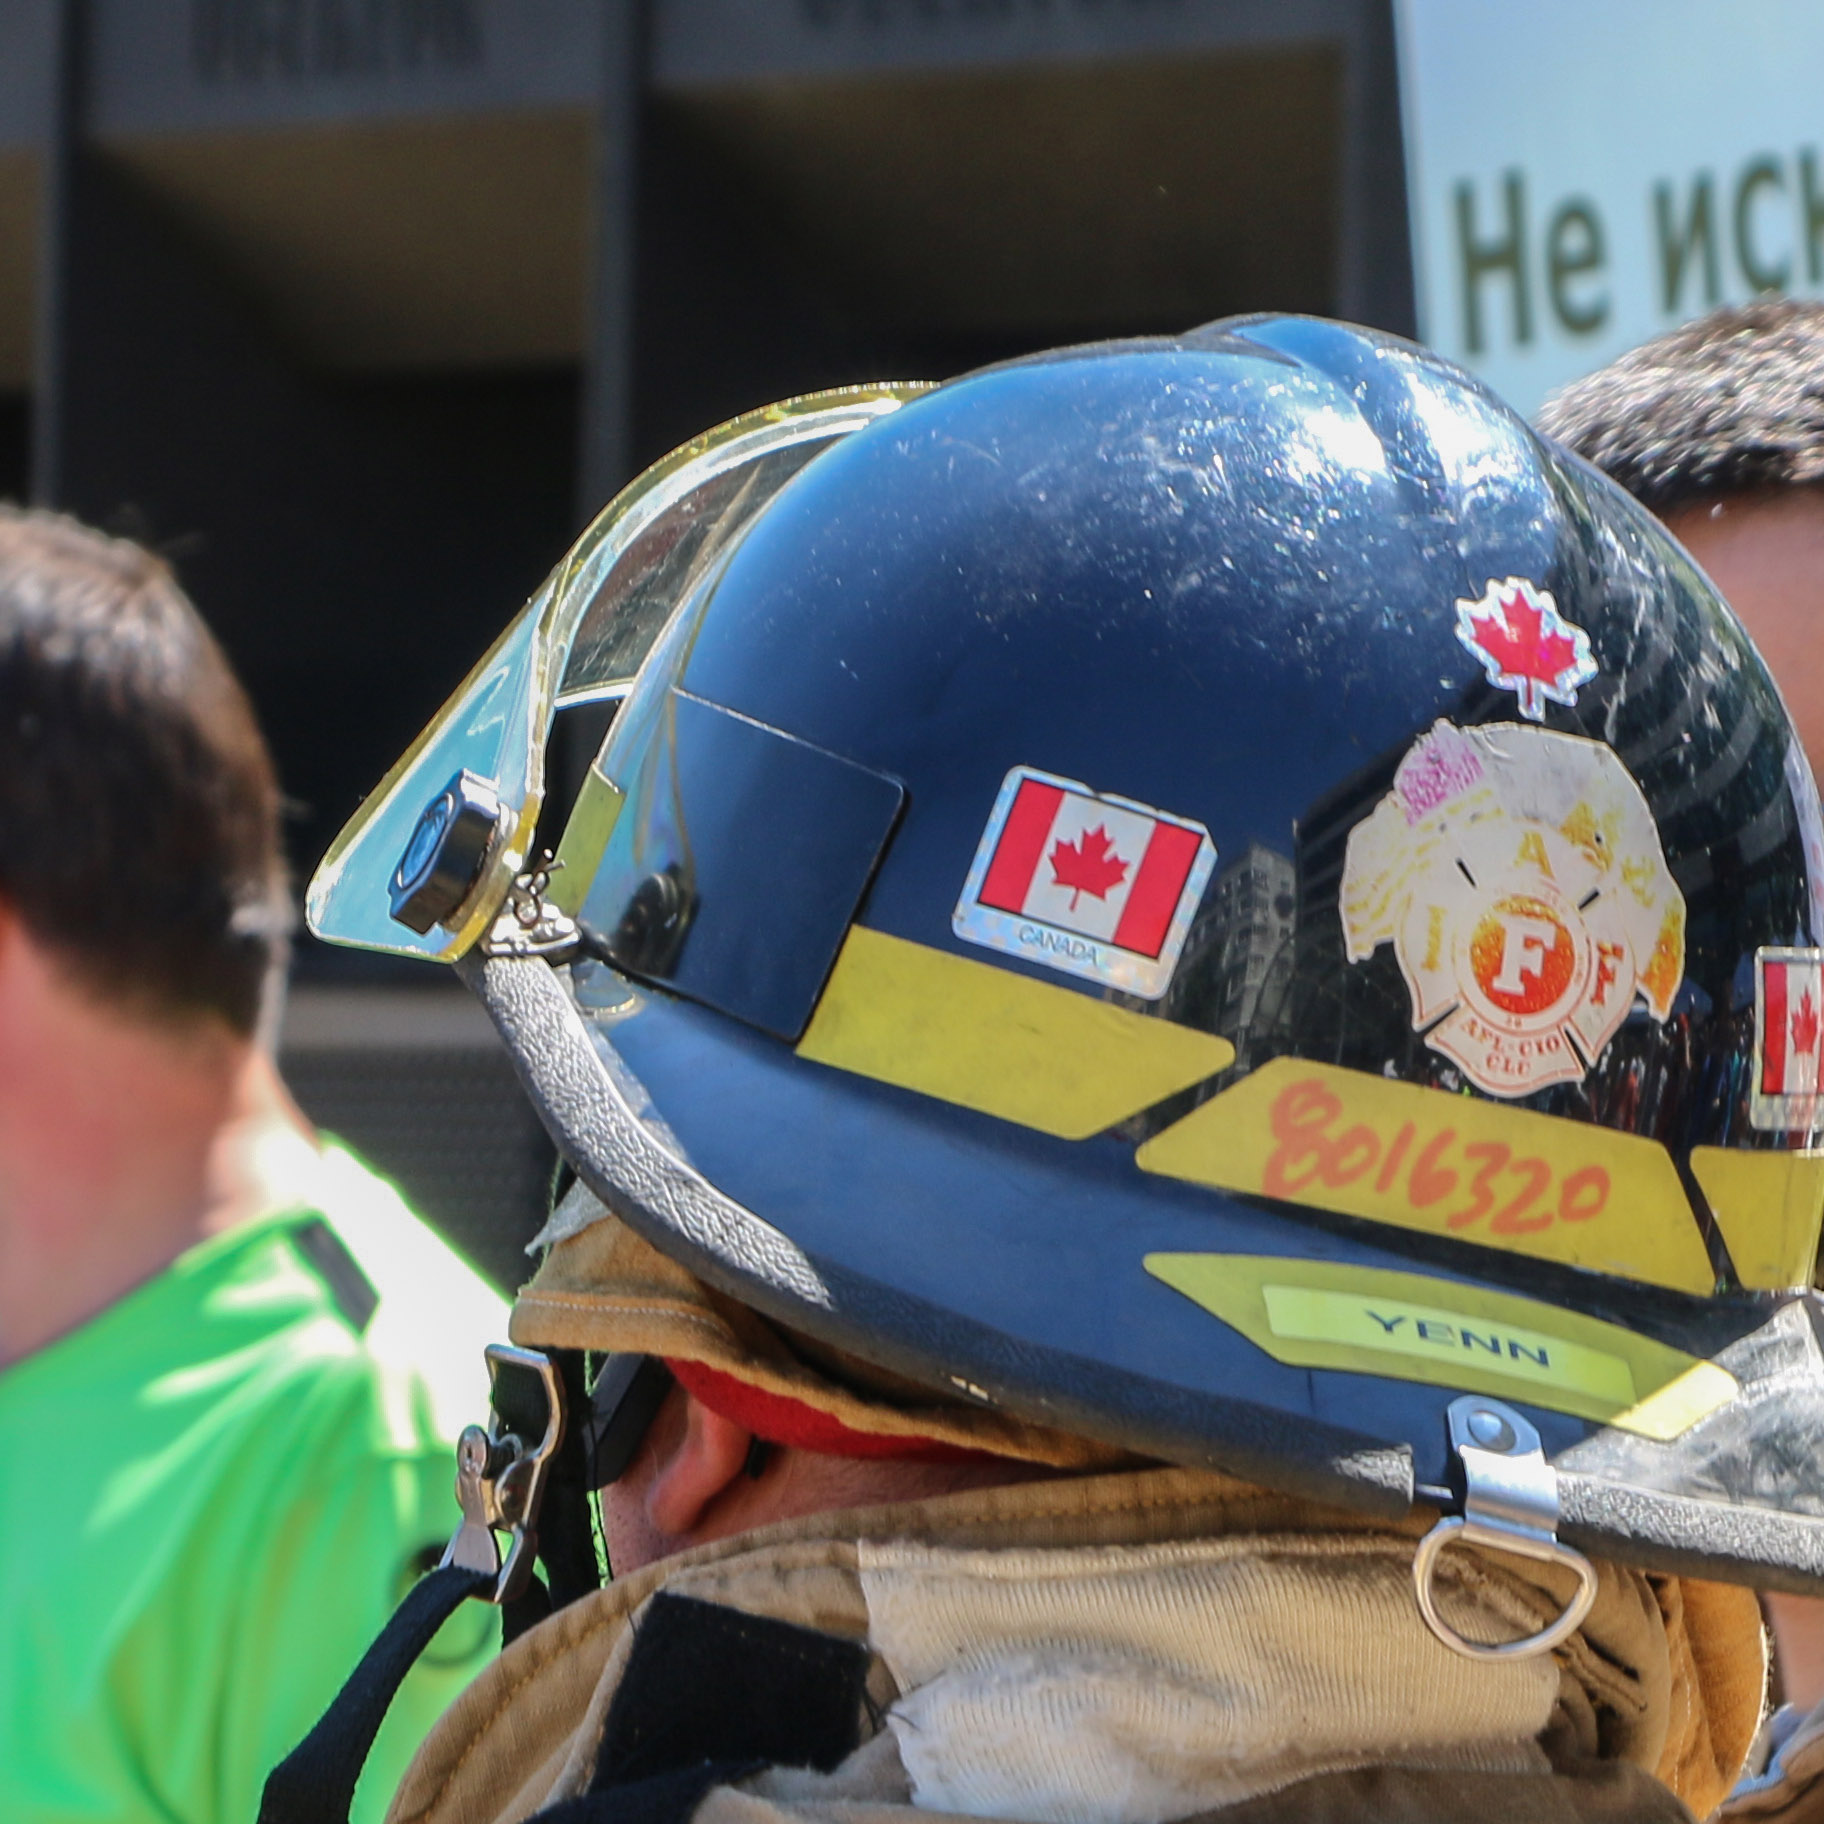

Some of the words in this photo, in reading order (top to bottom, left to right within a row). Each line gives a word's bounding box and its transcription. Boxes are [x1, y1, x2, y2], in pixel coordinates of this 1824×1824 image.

[1452, 165, 1610, 357] Не
[1018, 924, 1099, 968] CANADA
[1261, 1078, 1612, 1236] 8016320
[1364, 1307, 1551, 1369] YENN
